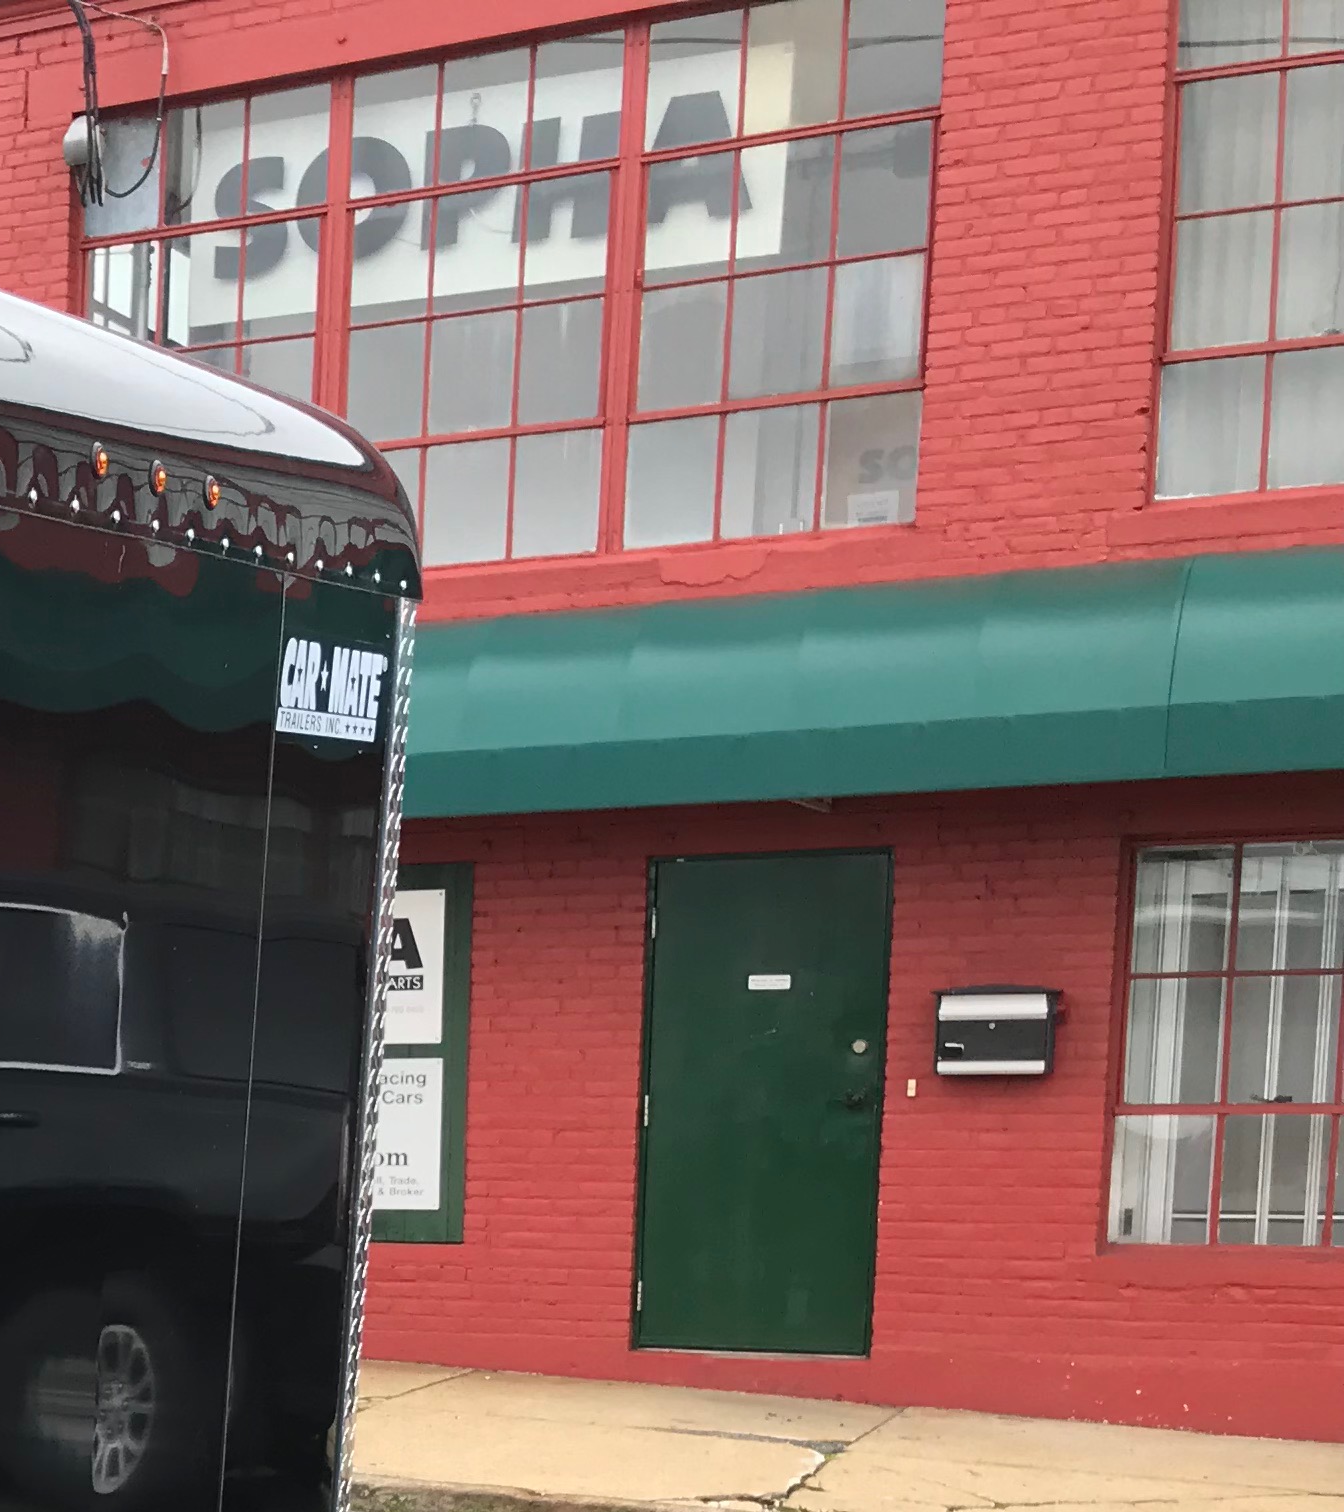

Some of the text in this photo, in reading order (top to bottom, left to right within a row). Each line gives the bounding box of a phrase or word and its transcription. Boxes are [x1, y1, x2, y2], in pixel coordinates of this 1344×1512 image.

[214, 91, 753, 279] SOPHA
[280, 637, 384, 719] CAR MATE
[279, 710, 323, 733] TRAILERS
[382, 1090, 424, 1106] Cars
